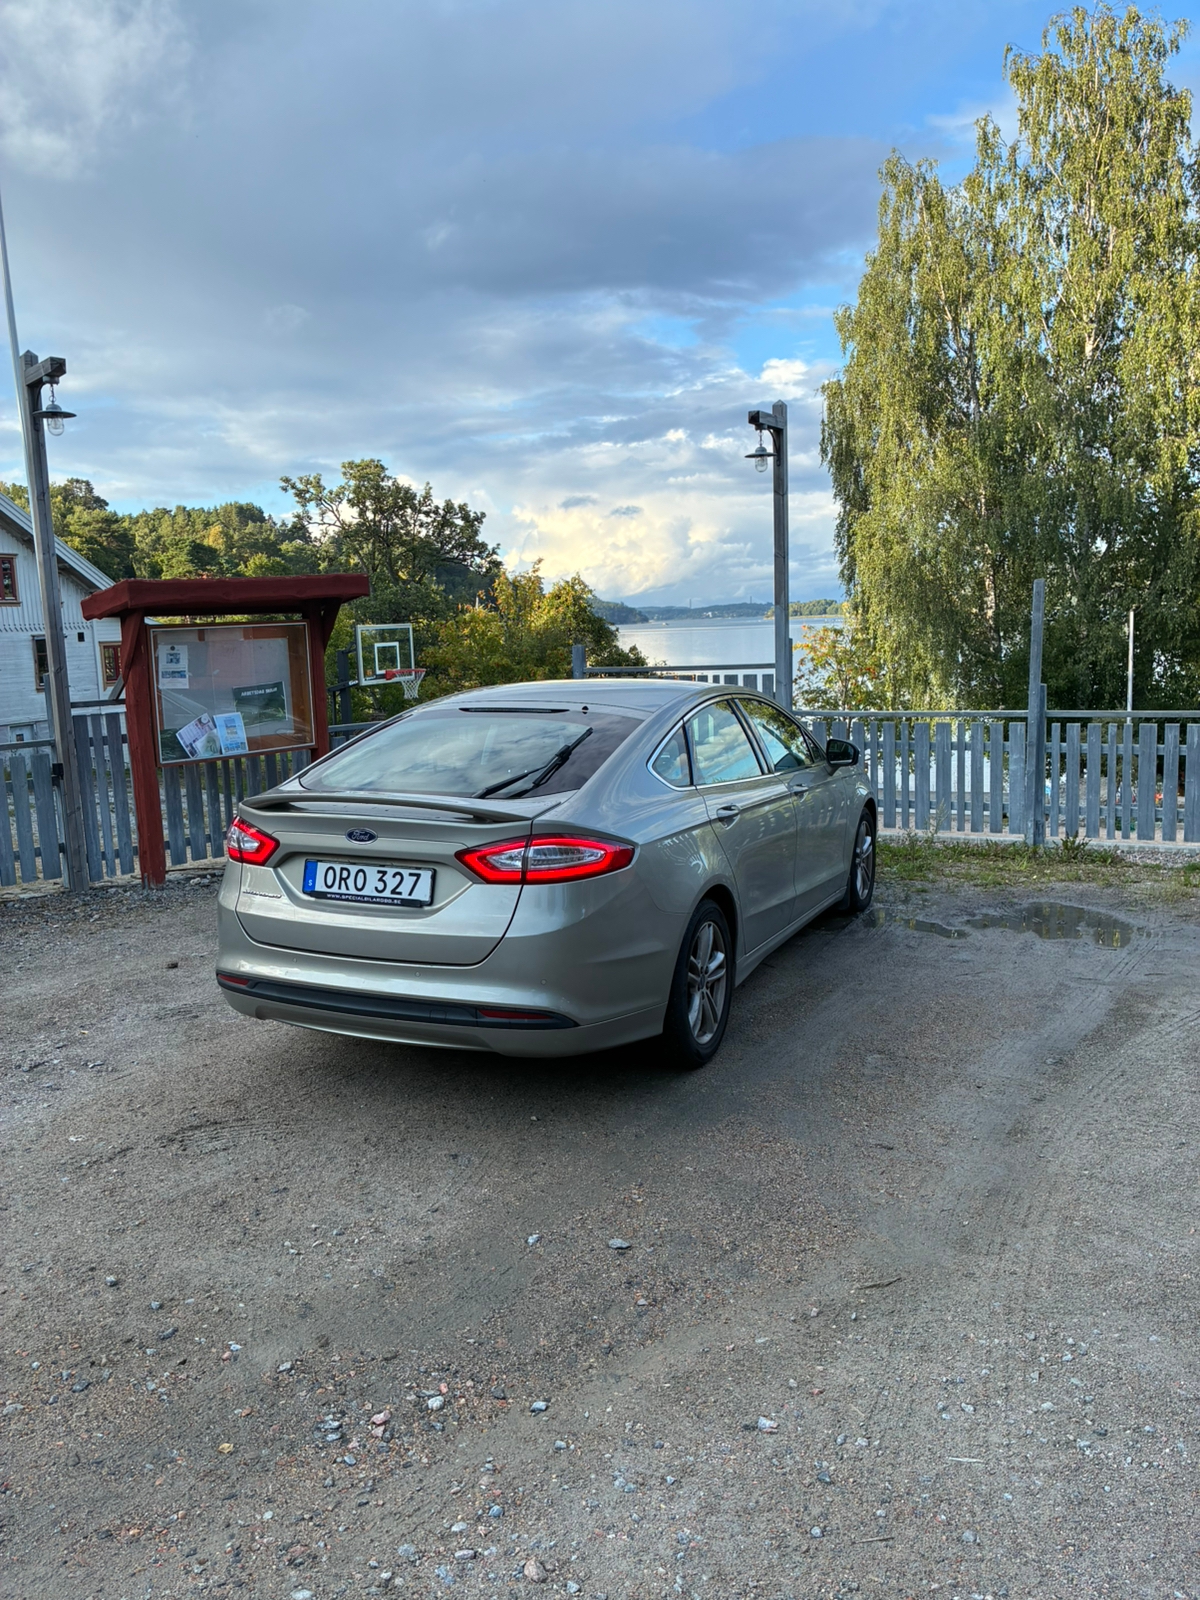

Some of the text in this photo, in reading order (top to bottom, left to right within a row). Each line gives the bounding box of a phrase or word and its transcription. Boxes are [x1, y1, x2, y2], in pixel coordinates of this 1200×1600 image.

[308, 879, 313, 887] S
[324, 865, 422, 897] ORO 327
